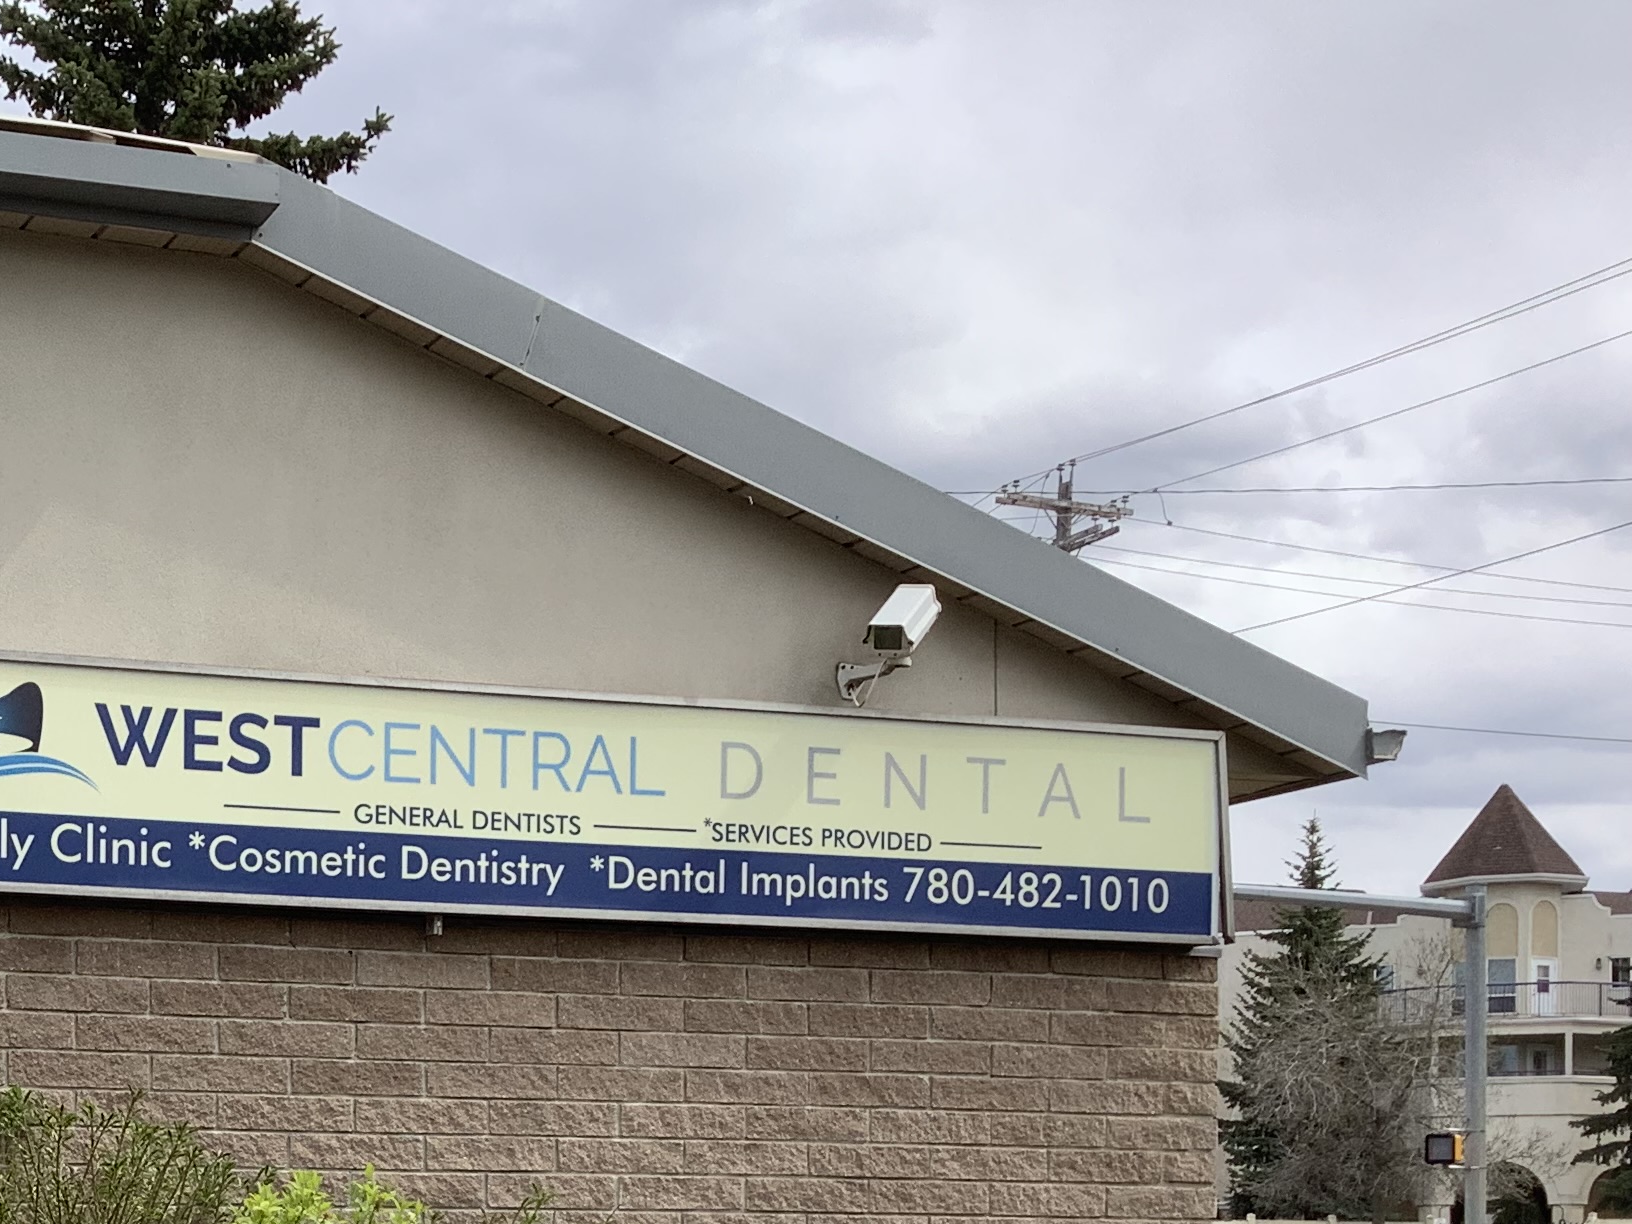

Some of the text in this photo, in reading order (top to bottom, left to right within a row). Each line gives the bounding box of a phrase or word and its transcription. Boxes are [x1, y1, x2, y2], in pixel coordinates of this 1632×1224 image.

[718, 740, 1152, 824] DENTAL
[50, 822, 173, 868] Clinic
[400, 844, 566, 897] Dentistry
[740, 861, 890, 907] Implants
[902, 866, 1169, 915] 780-482-1010
[353, 803, 464, 830] GENERAL
[472, 810, 582, 836] DENTISTS
[822, 828, 933, 852] PROVIDED
